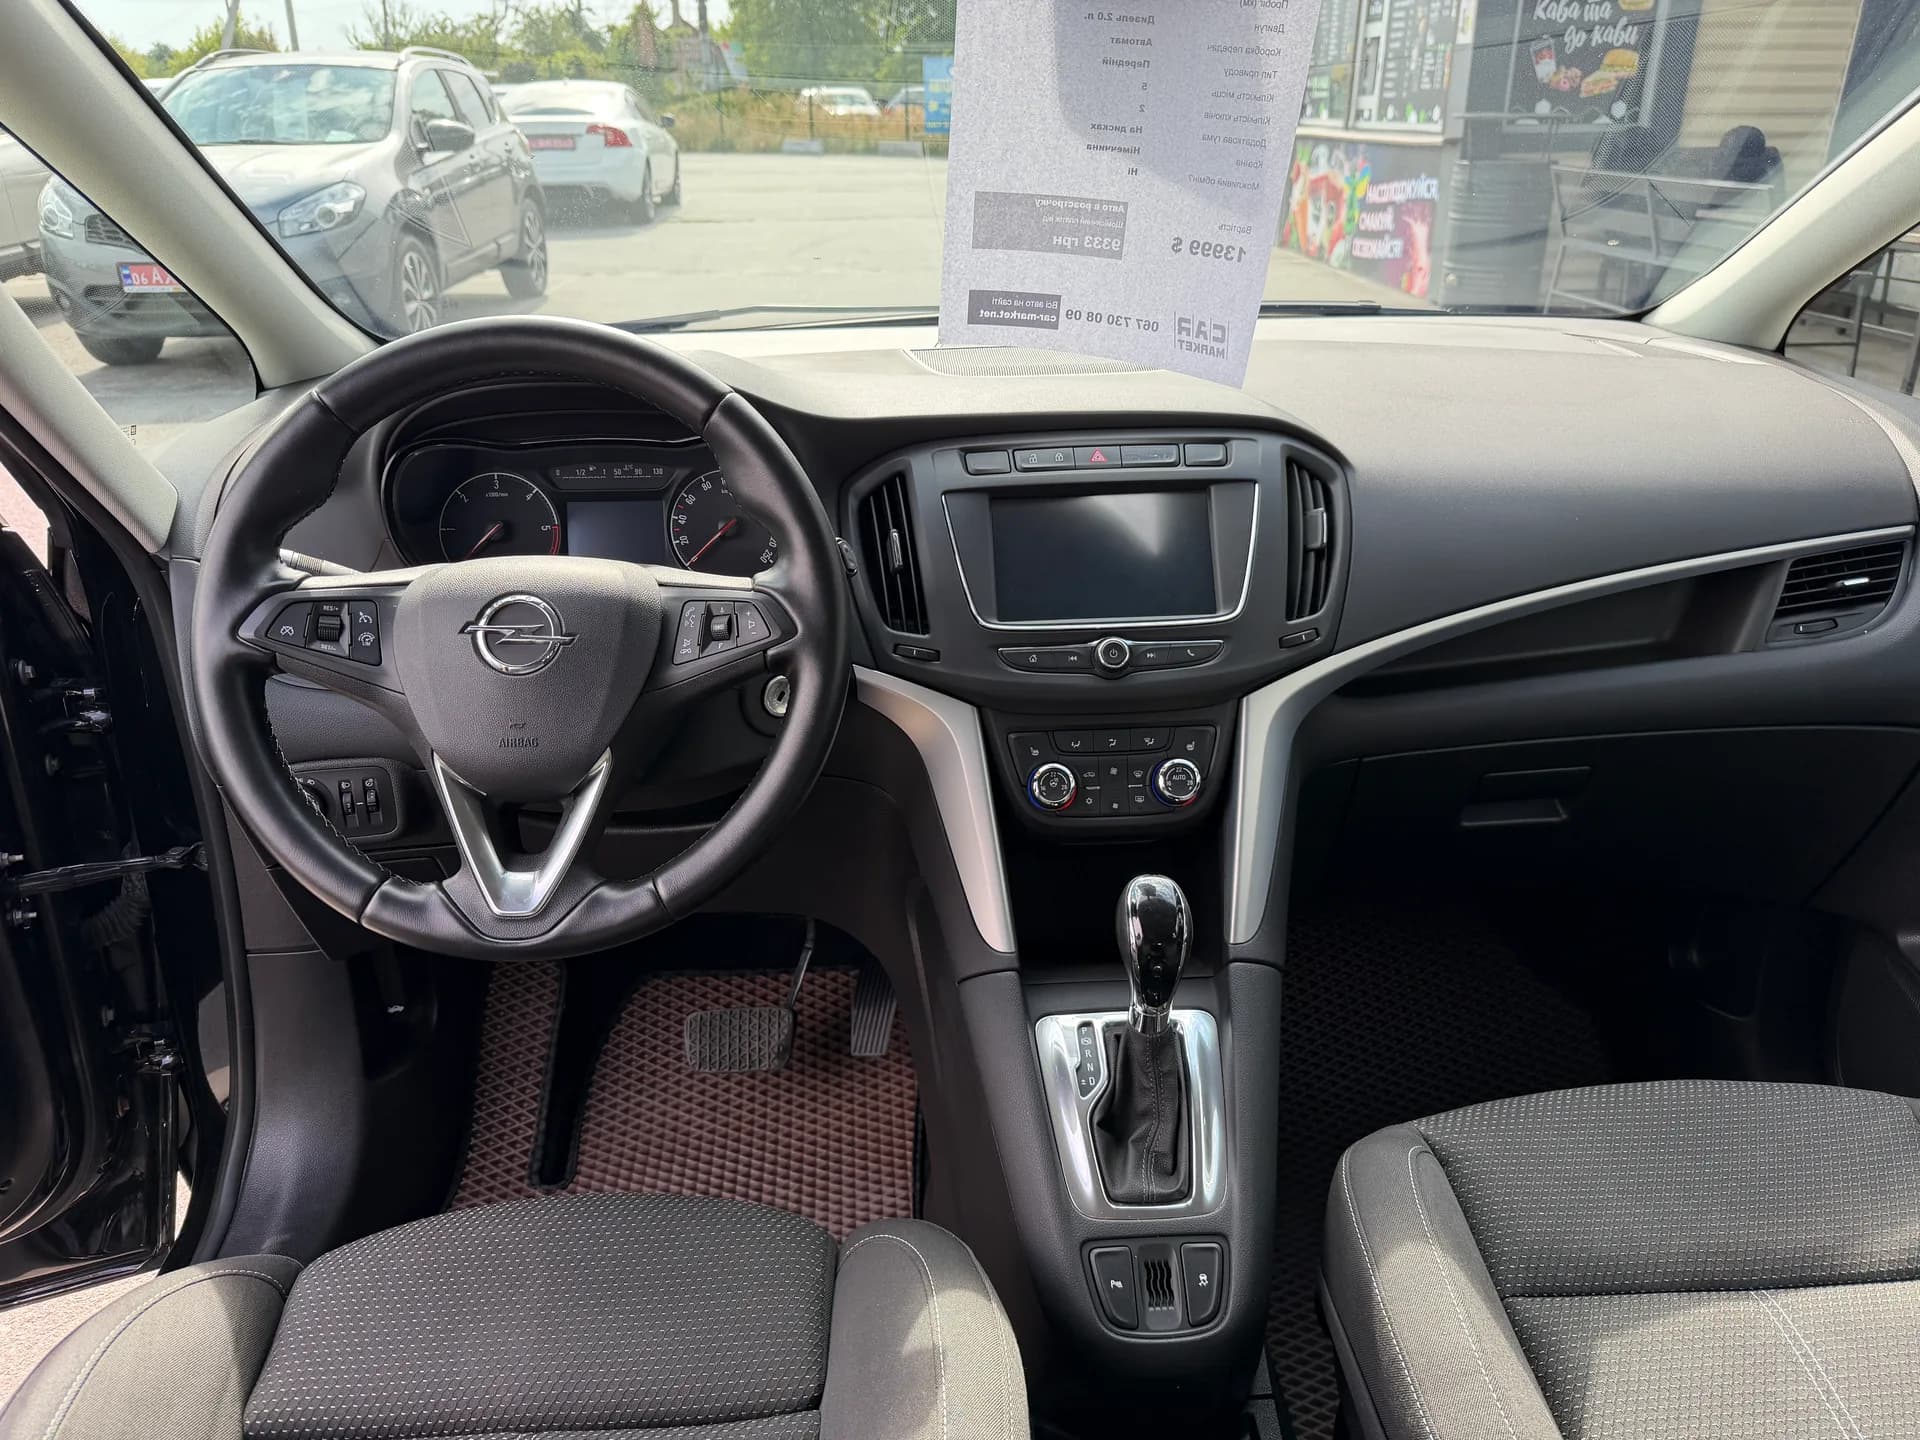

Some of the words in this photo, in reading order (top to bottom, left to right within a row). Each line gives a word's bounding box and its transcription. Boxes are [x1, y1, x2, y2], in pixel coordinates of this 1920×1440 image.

[1533, 0, 1582, 23] Кава
[1583, 0, 1613, 22] та
[1563, 25, 1587, 54] до
[1591, 16, 1638, 47] кави
[494, 480, 499, 489] 3
[701, 481, 712, 491] 80
[685, 494, 696, 505] 60
[678, 514, 687, 525] 40
[679, 535, 689, 546] 20
[760, 549, 773, 563] 250
[499, 737, 539, 748] AIRBAG
[1081, 1027, 1087, 1035] P
[1085, 1049, 1092, 1057] R
[1087, 1063, 1094, 1071] N
[1089, 1076, 1096, 1085] D
